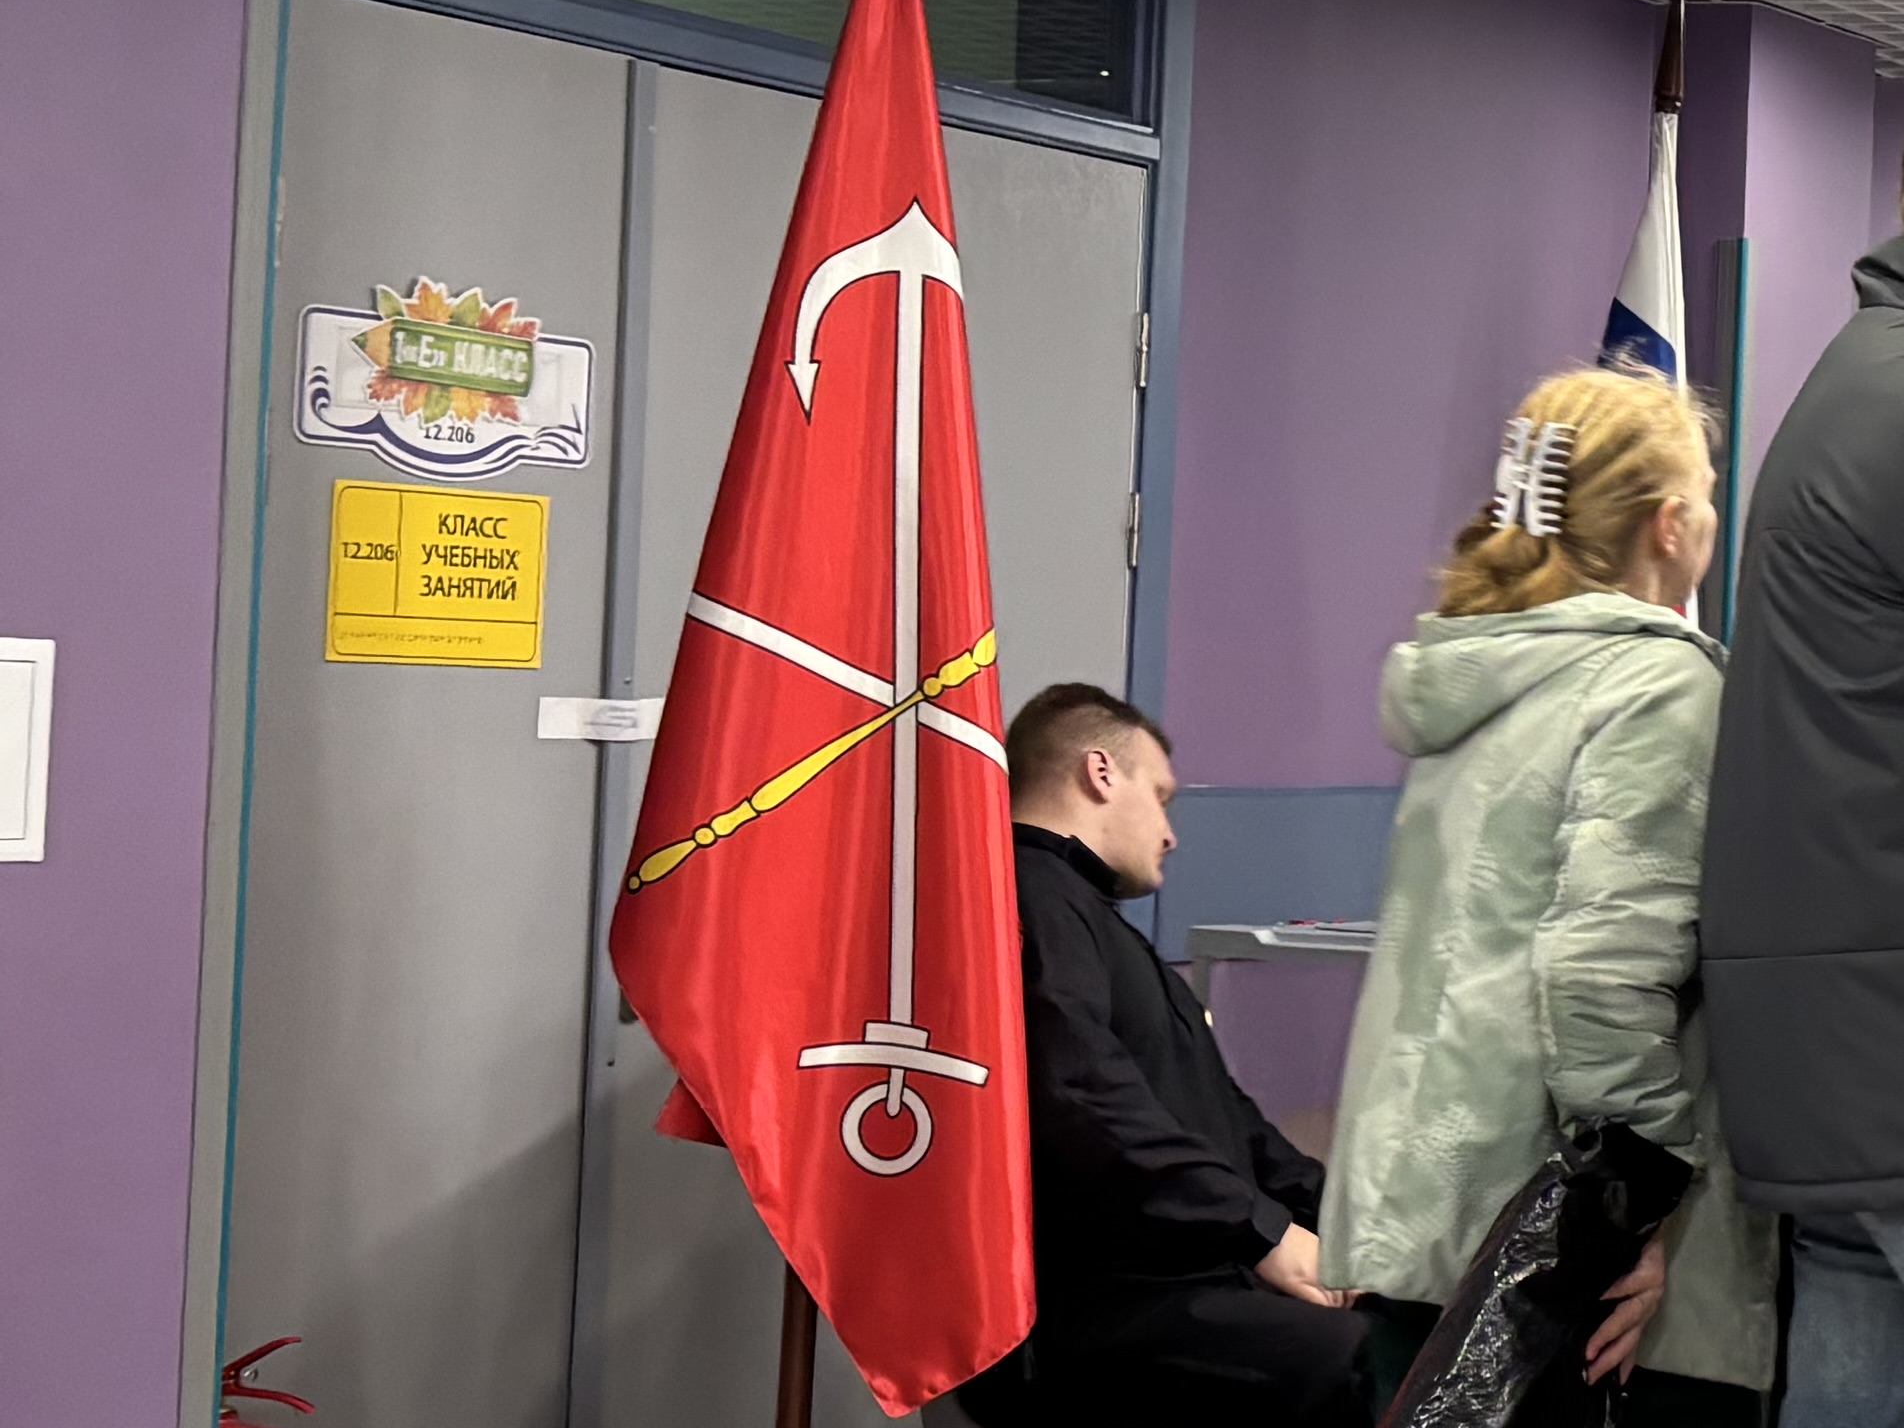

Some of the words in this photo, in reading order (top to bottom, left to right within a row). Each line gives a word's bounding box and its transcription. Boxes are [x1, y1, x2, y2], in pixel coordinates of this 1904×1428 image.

[453, 340, 528, 383] КЛАСС
[438, 512, 508, 540] КЛАСС
[421, 543, 520, 571] УЧЕБНЫХ
[418, 574, 518, 602] ЗАНЯТИЙ
